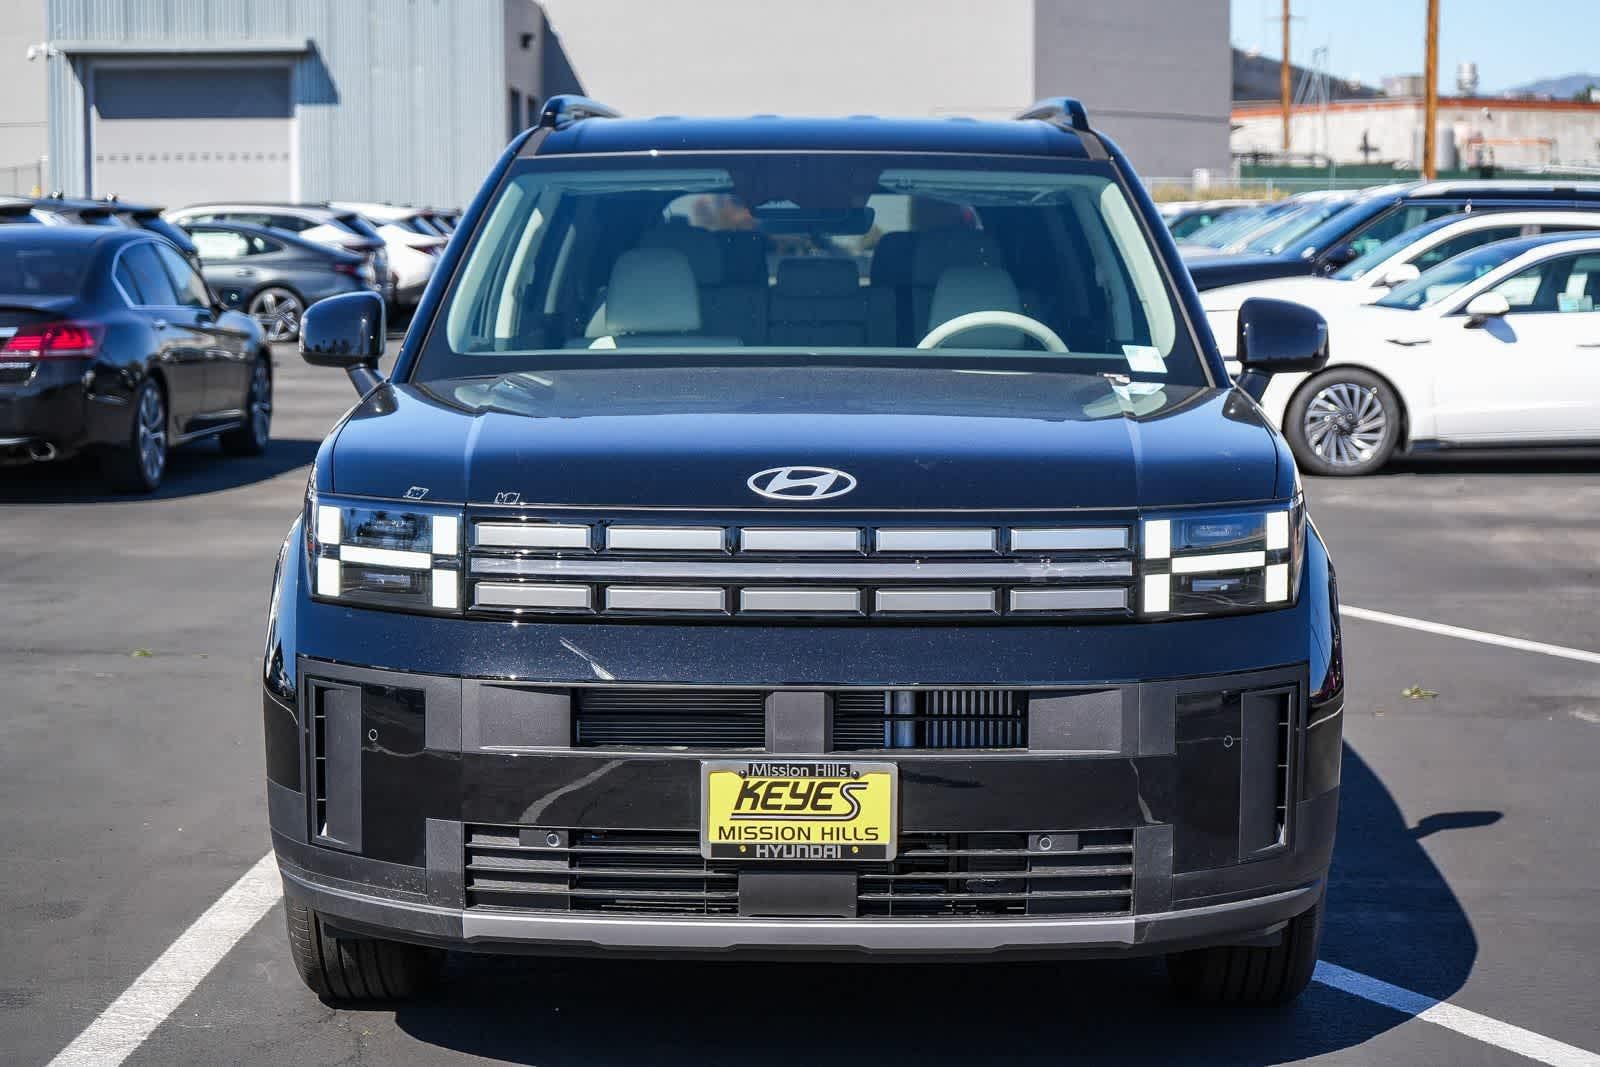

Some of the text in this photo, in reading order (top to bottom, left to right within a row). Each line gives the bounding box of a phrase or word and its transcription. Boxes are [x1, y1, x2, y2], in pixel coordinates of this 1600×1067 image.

[751, 764, 848, 777] Mission Hills
[731, 780, 869, 821] KEYES
[718, 826, 879, 841] MISSION HILLS
[756, 844, 841, 859] HYUNDAI
